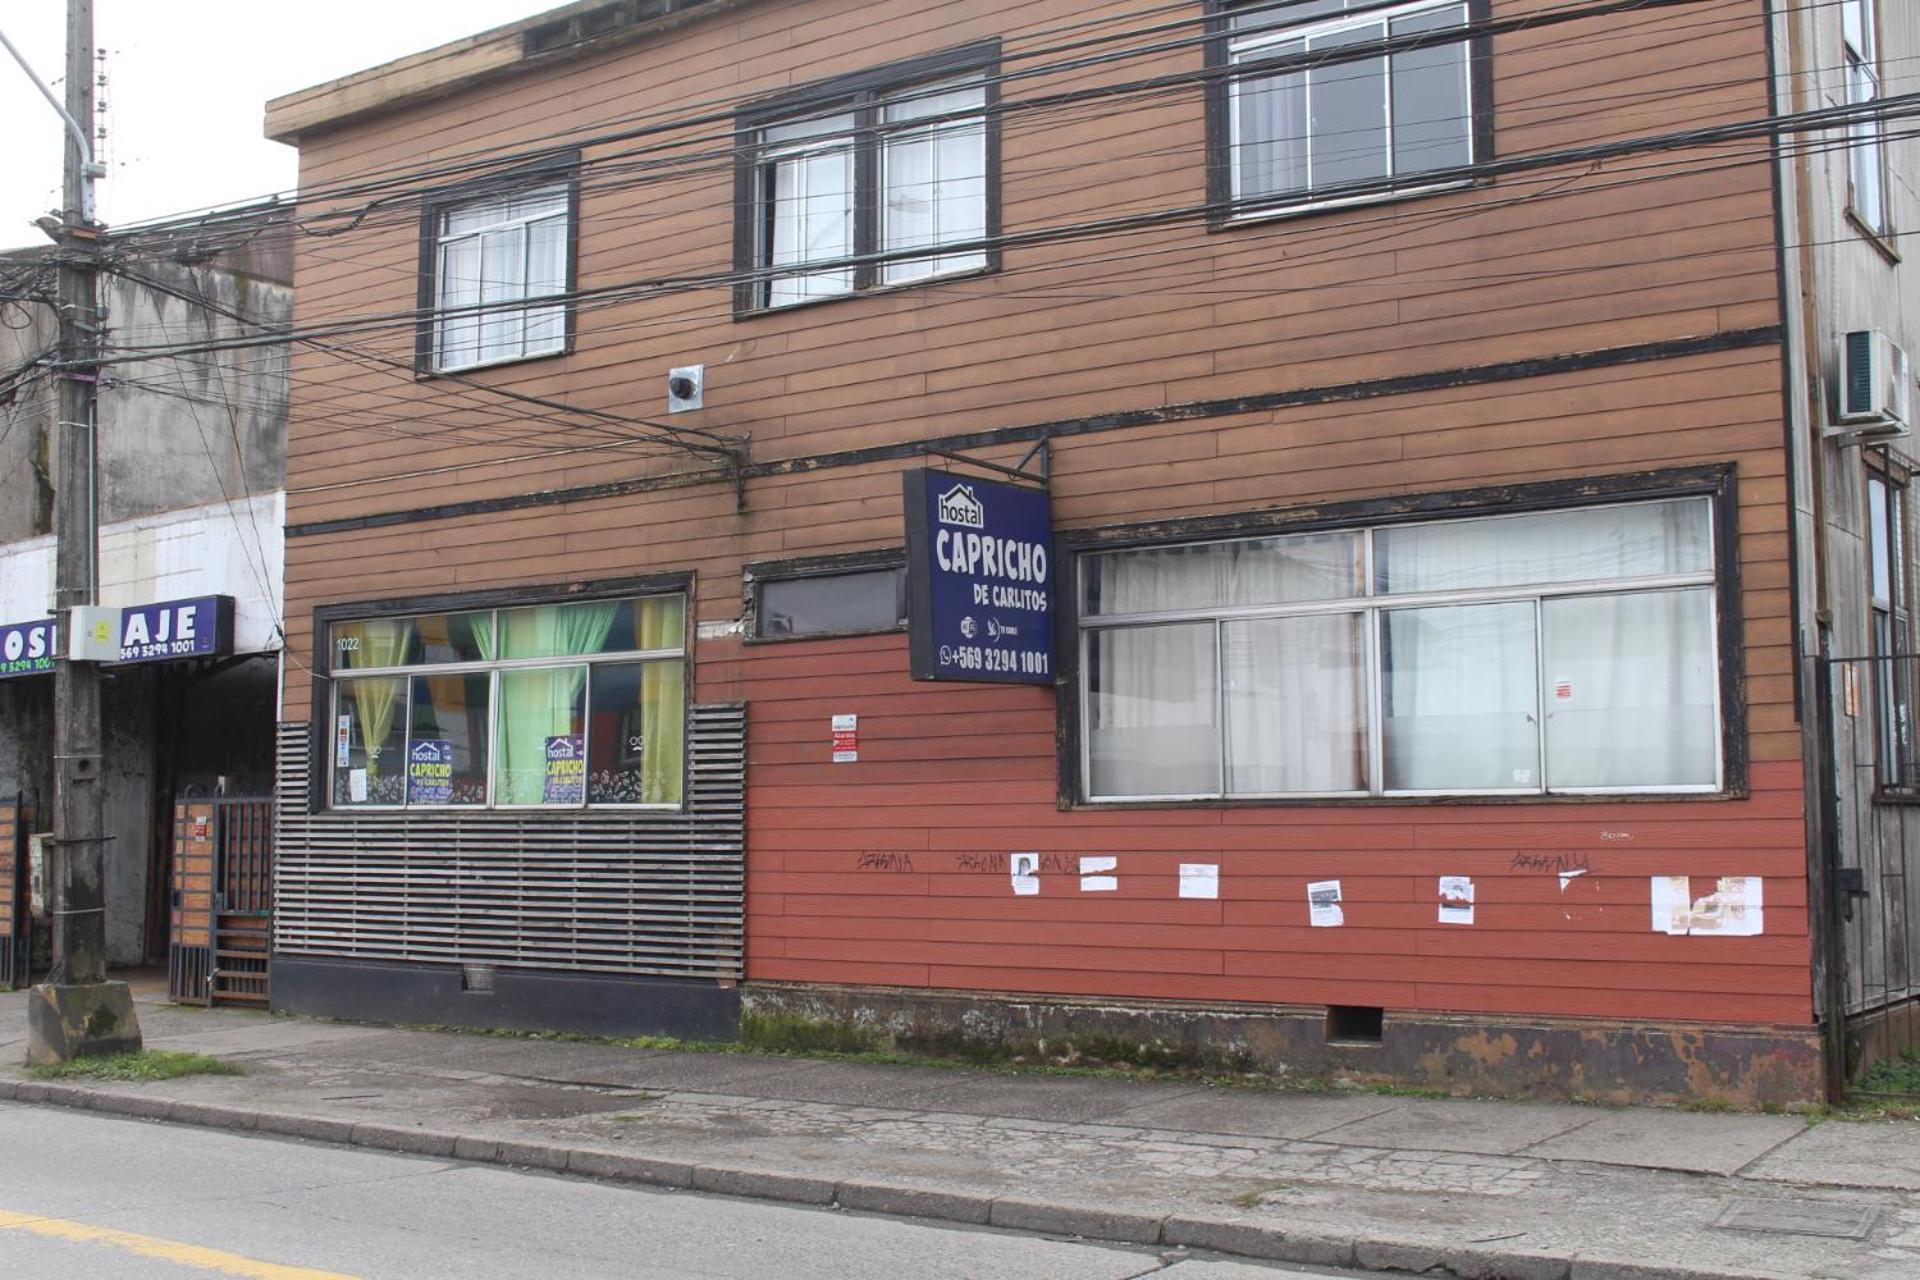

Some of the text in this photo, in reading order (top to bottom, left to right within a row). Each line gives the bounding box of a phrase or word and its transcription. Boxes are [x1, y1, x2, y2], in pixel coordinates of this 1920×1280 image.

[941, 498, 981, 525] hostal
[937, 529, 1047, 584] CAPRICHO
[974, 583, 1047, 612] DE CARLITOS
[171, 640, 195, 653] 1001
[336, 637, 360, 650] 1022
[952, 646, 1048, 674] +569 3294 1001
[412, 749, 440, 760] hostal
[548, 746, 574, 758] hostal
[411, 763, 452, 777] CAPRICHO
